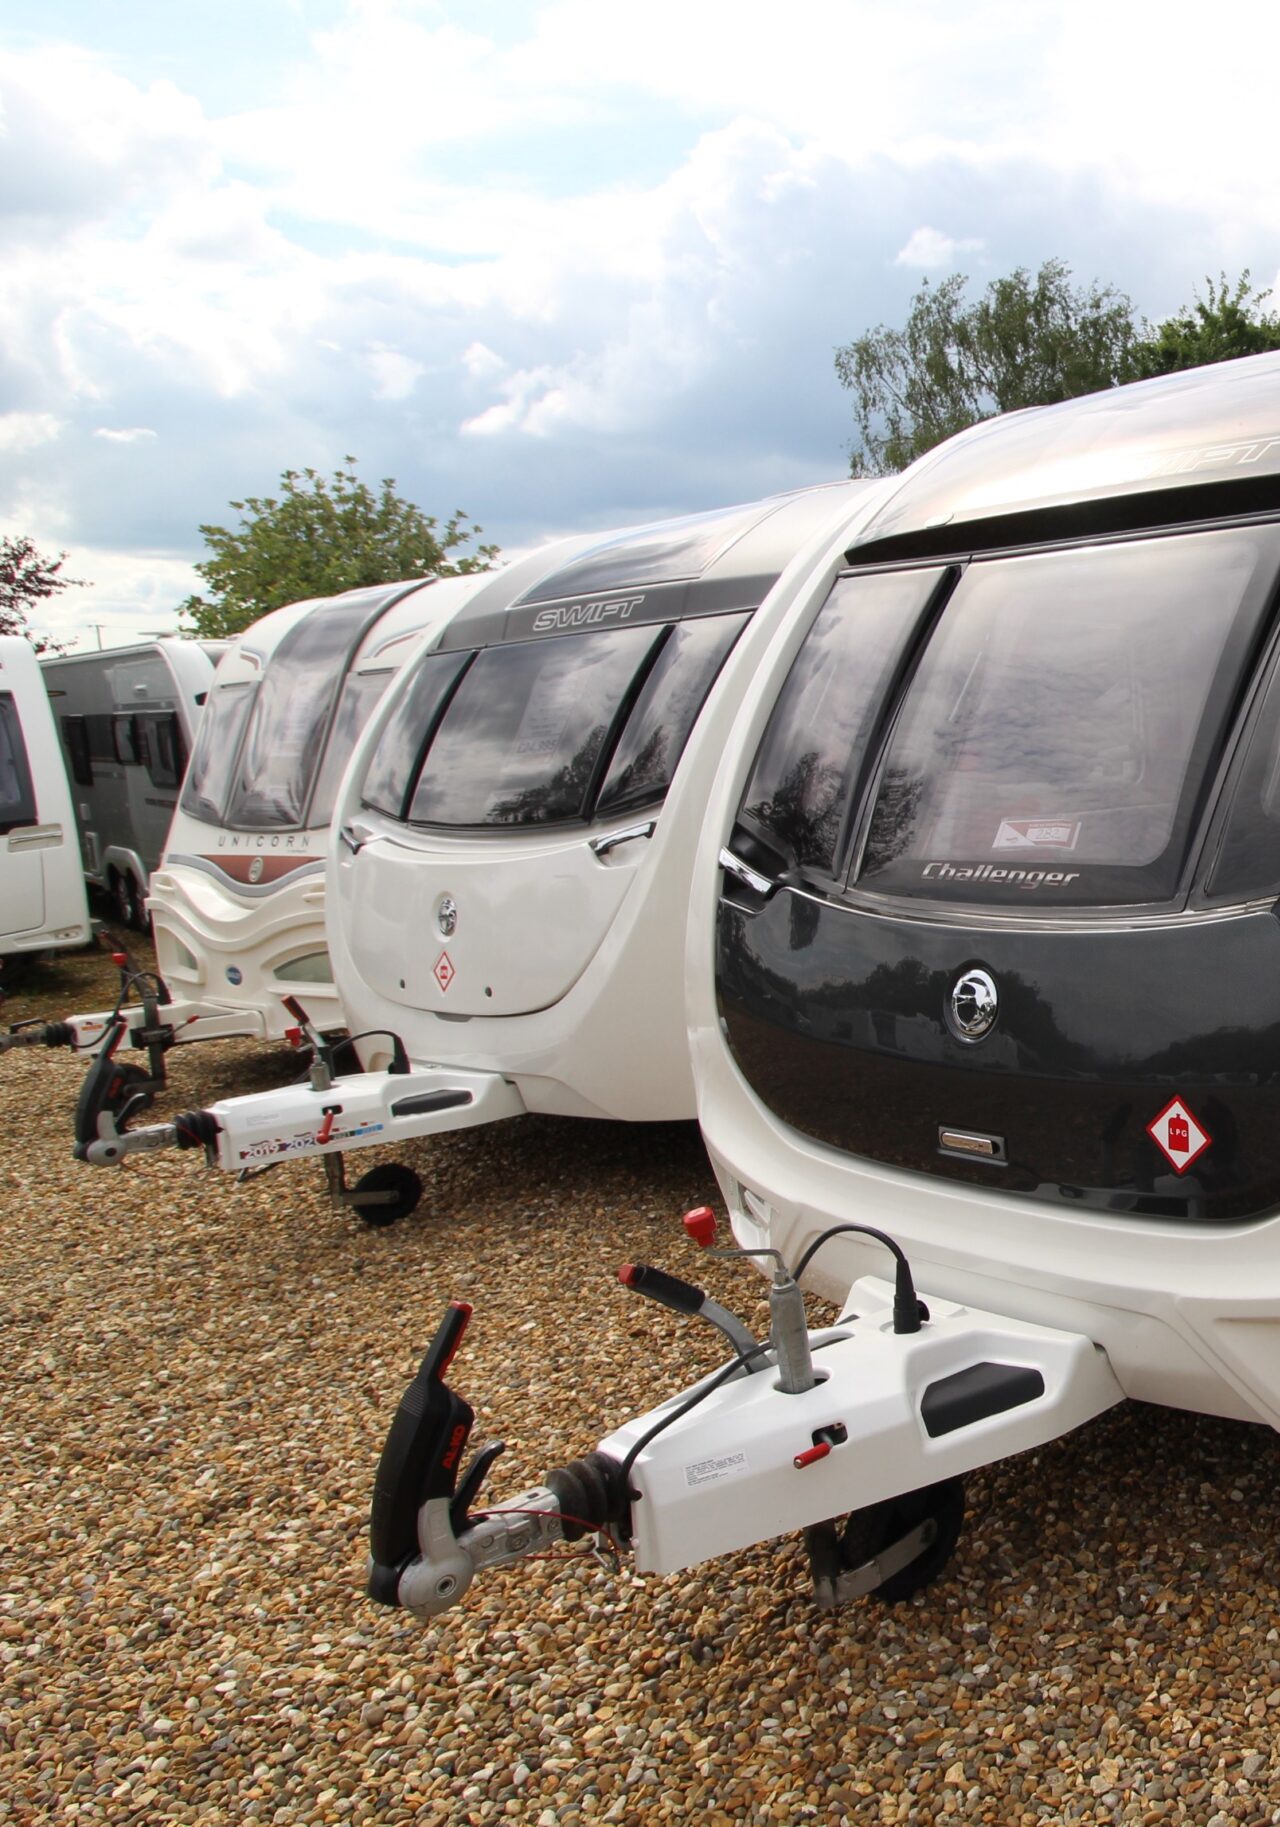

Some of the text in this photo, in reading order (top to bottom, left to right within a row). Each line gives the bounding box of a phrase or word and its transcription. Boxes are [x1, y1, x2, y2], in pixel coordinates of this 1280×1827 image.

[532, 595, 645, 631] SWIFT
[217, 835, 310, 847] UNICORN
[921, 862, 1080, 890] Challenger
[1169, 1127, 1188, 1138] LPG
[245, 1144, 279, 1158] 2019
